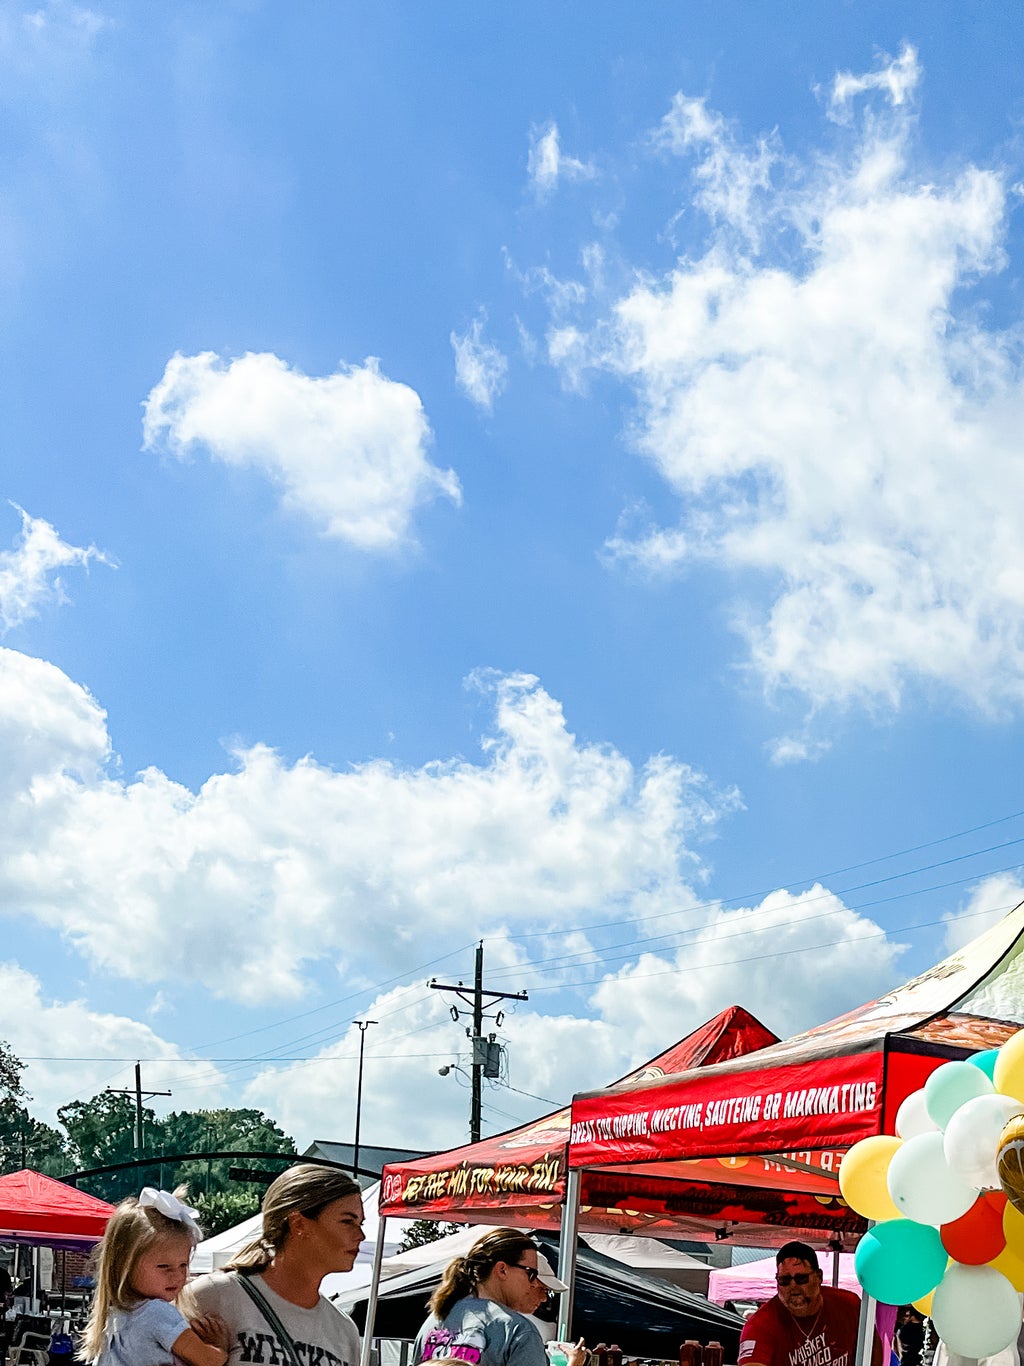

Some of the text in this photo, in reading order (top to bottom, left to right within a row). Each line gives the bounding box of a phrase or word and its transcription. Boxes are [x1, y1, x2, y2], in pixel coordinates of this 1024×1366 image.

[570, 1081, 877, 1145] GREAT FOR DIPPING, INJECTING, SAUTEING OR MARINATING
[402, 1152, 560, 1201] GET THE MIX FOR YOUR FIX!
[789, 1332, 826, 1366] WHISKEY
